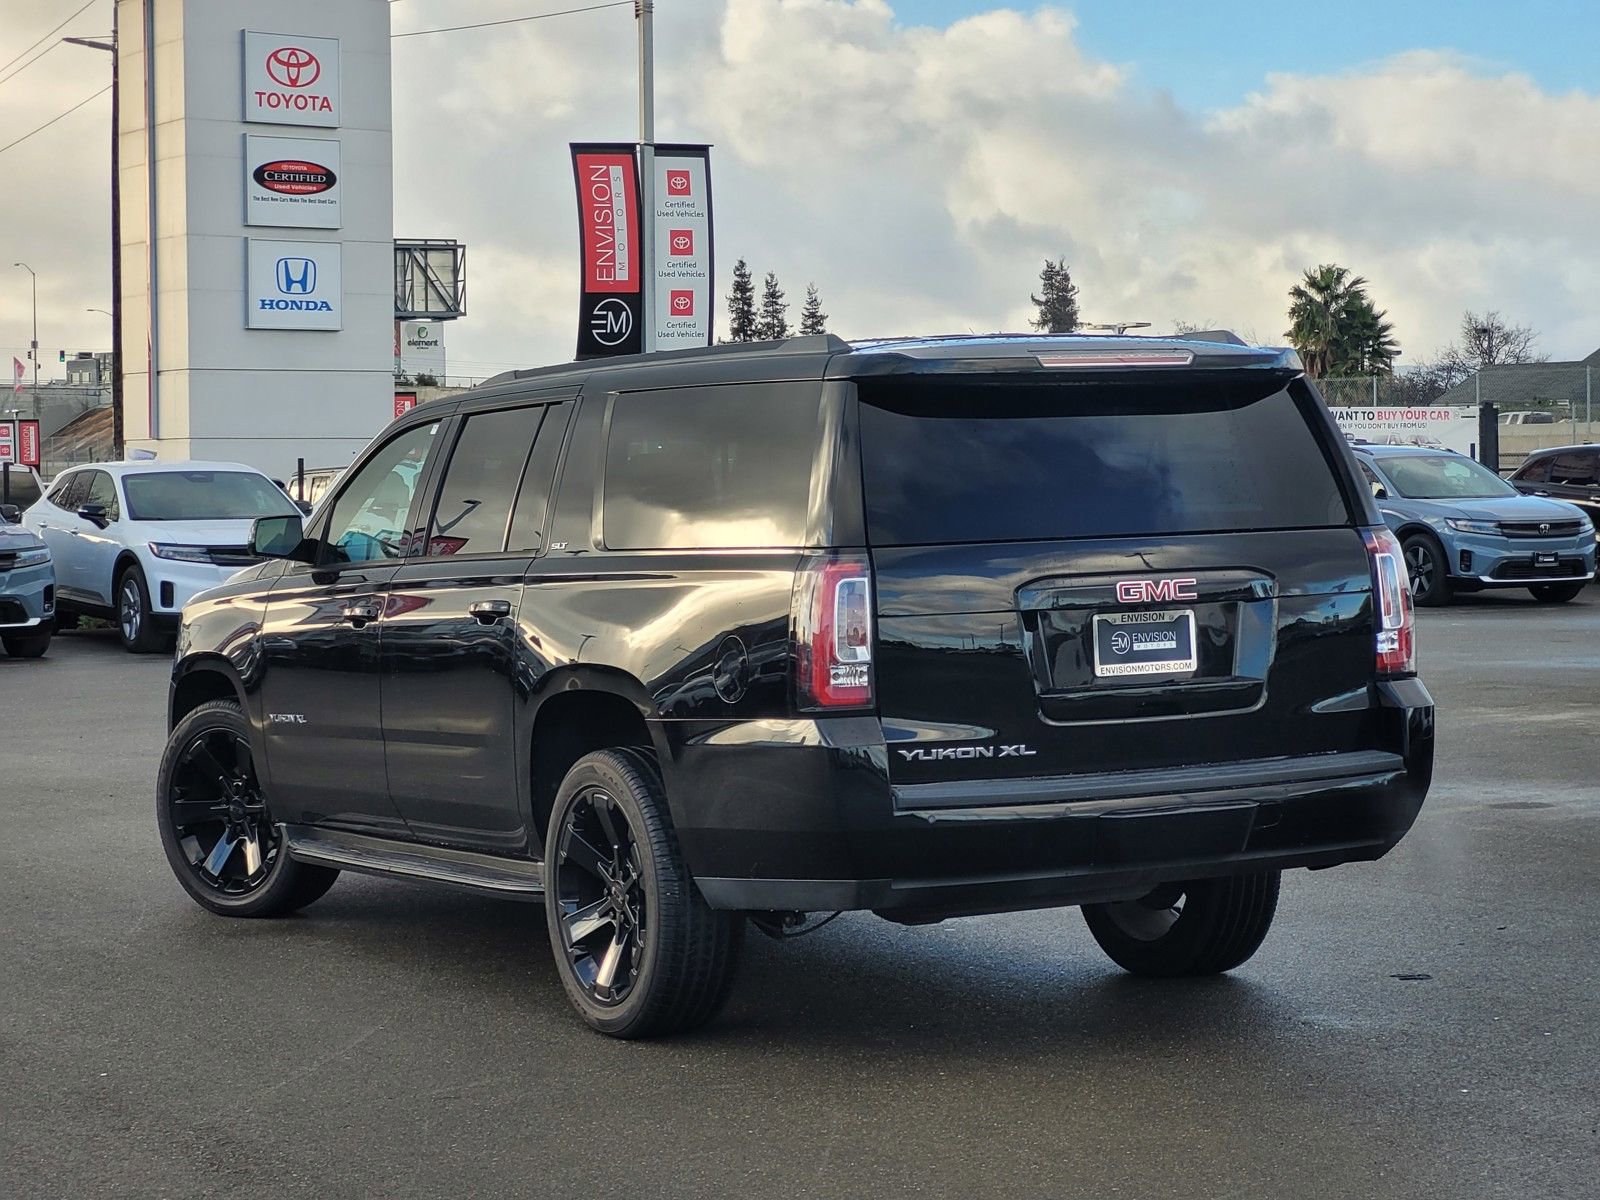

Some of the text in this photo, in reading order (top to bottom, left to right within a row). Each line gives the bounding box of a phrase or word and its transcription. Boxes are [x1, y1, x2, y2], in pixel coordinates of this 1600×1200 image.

[255, 92, 332, 112] TOYOTA
[264, 171, 326, 183] CERTIFIED
[664, 200, 696, 209] Certified
[589, 165, 614, 281] ENVISION
[614, 176, 626, 270] MOTORS
[666, 261, 697, 269] Certified
[679, 270, 706, 278] Vehicles
[260, 299, 333, 312] HONDA
[407, 339, 438, 347] element
[1361, 411, 1375, 420] TO
[1377, 411, 1398, 420] BUY
[1400, 410, 1428, 420] YOUR
[1430, 410, 1450, 420] CAR
[1116, 578, 1198, 602] GMC
[1121, 613, 1165, 623] ENVISION
[1132, 632, 1176, 643] ENVISION
[1100, 662, 1192, 676] ENVISIONMOTORS.COM
[898, 744, 1036, 761] YUKON XL
